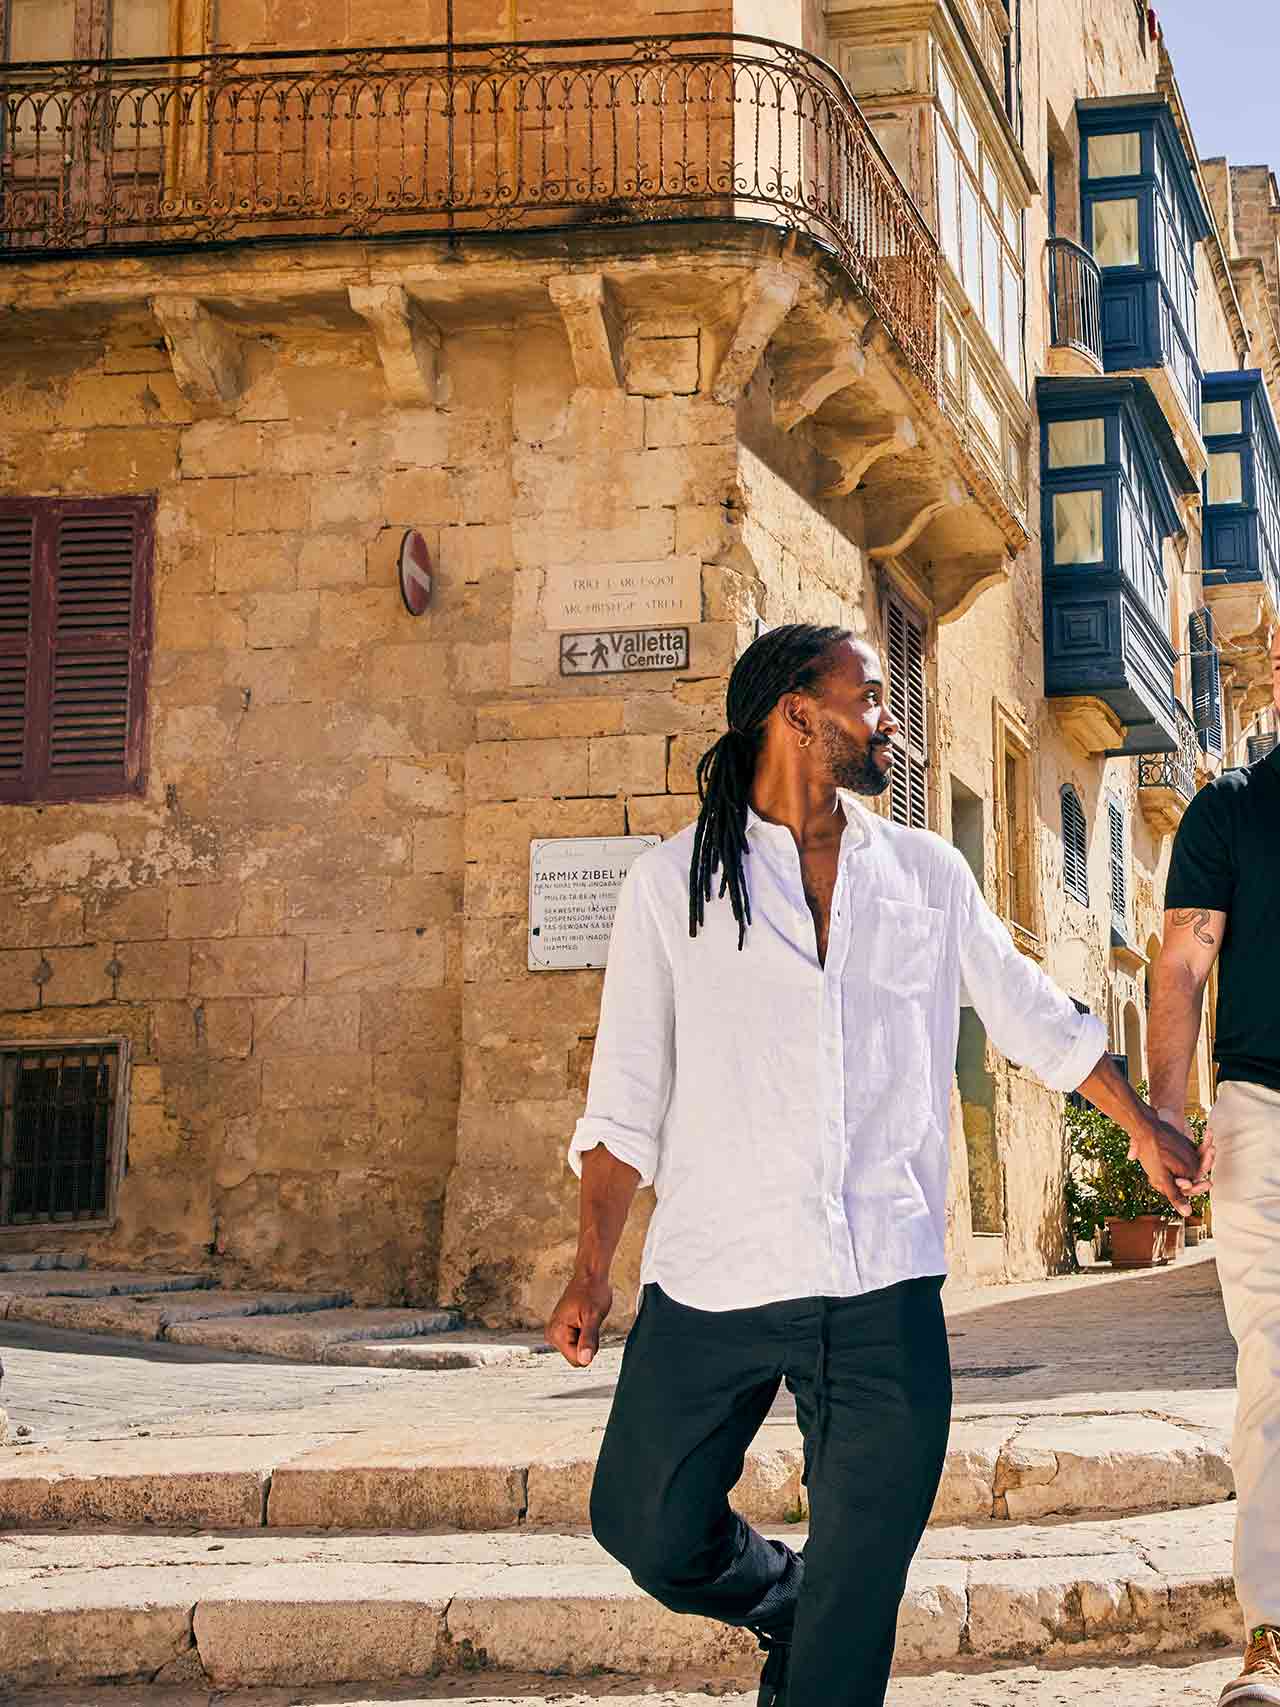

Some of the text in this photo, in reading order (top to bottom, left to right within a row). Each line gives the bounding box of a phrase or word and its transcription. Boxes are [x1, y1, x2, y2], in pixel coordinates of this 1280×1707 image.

[609, 632, 684, 654] Valletta
[622, 651, 680, 669] (Centre)
[535, 871, 579, 881] TARMIX
